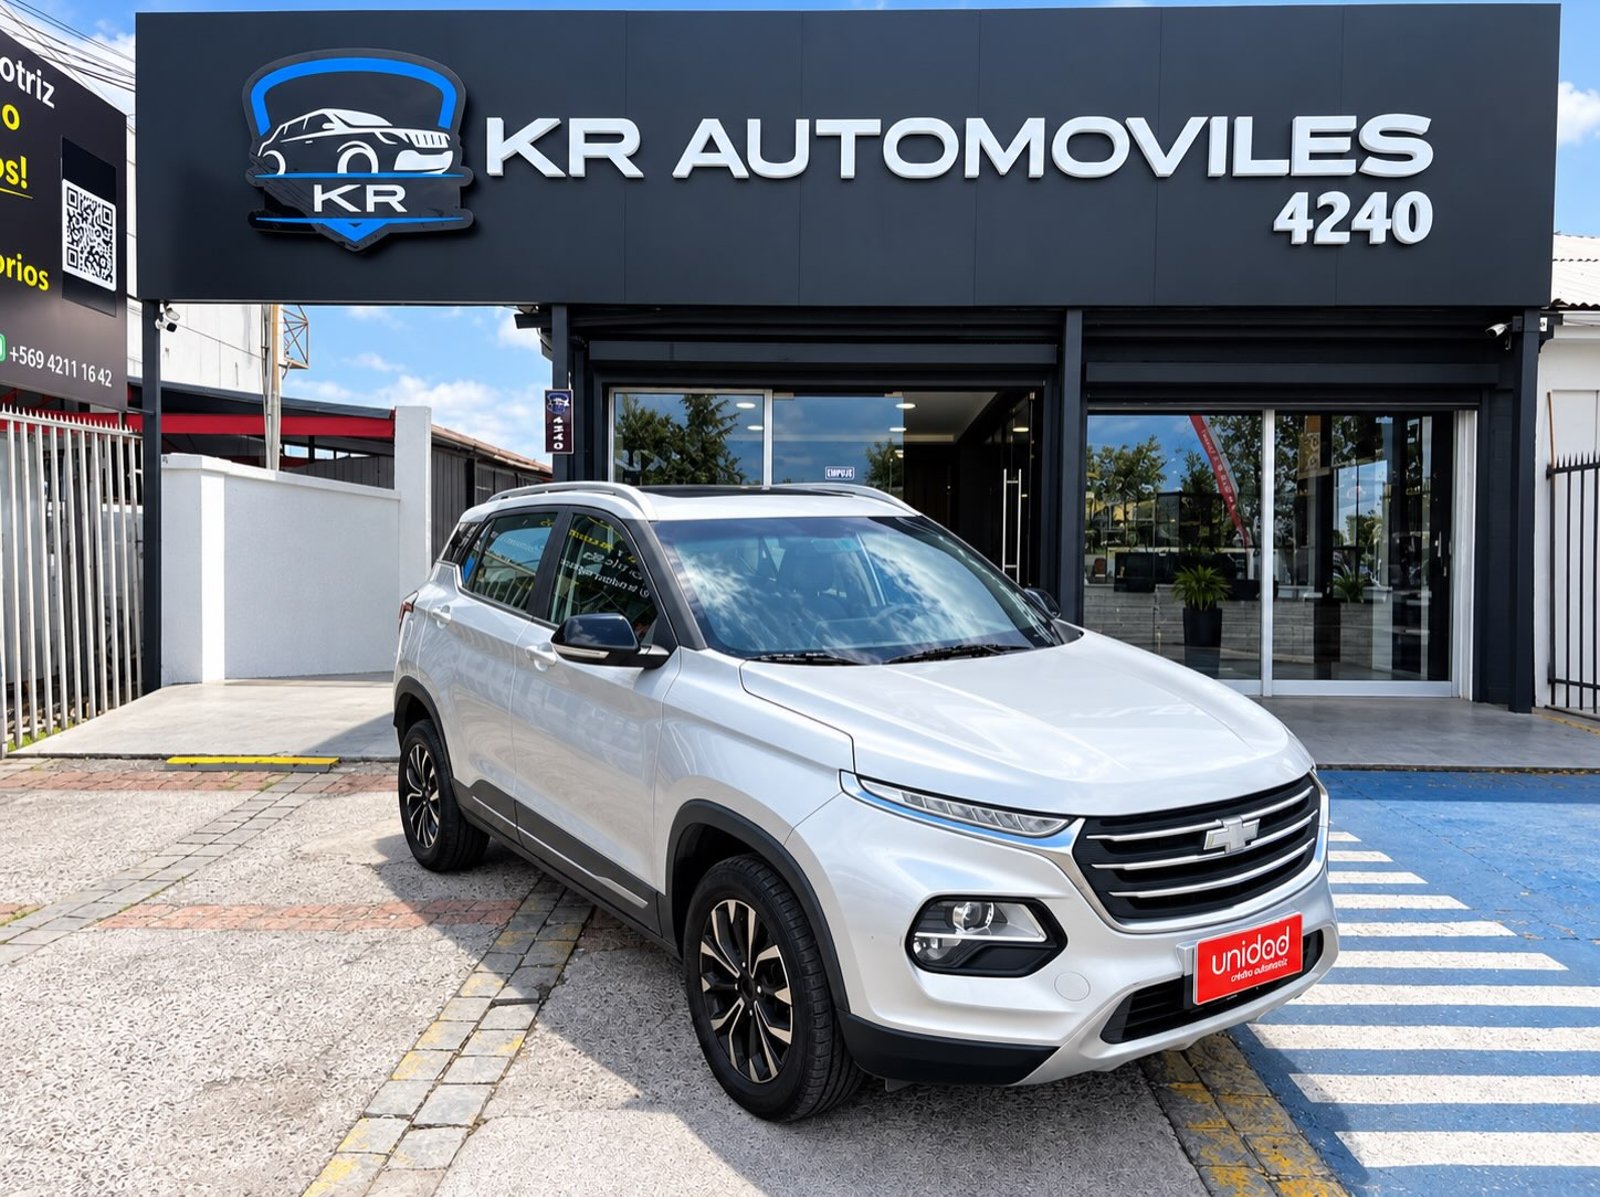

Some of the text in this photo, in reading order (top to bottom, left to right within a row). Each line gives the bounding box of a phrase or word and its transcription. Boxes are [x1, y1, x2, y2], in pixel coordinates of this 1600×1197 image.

[486, 113, 1434, 180] KR AUTOMOVILES
[0, 154, 28, 189] s!
[313, 183, 408, 213] KR
[1272, 190, 1434, 245] 4240
[9, 345, 45, 369] +569
[46, 353, 77, 379] 4211
[1212, 925, 1290, 975] unidad
